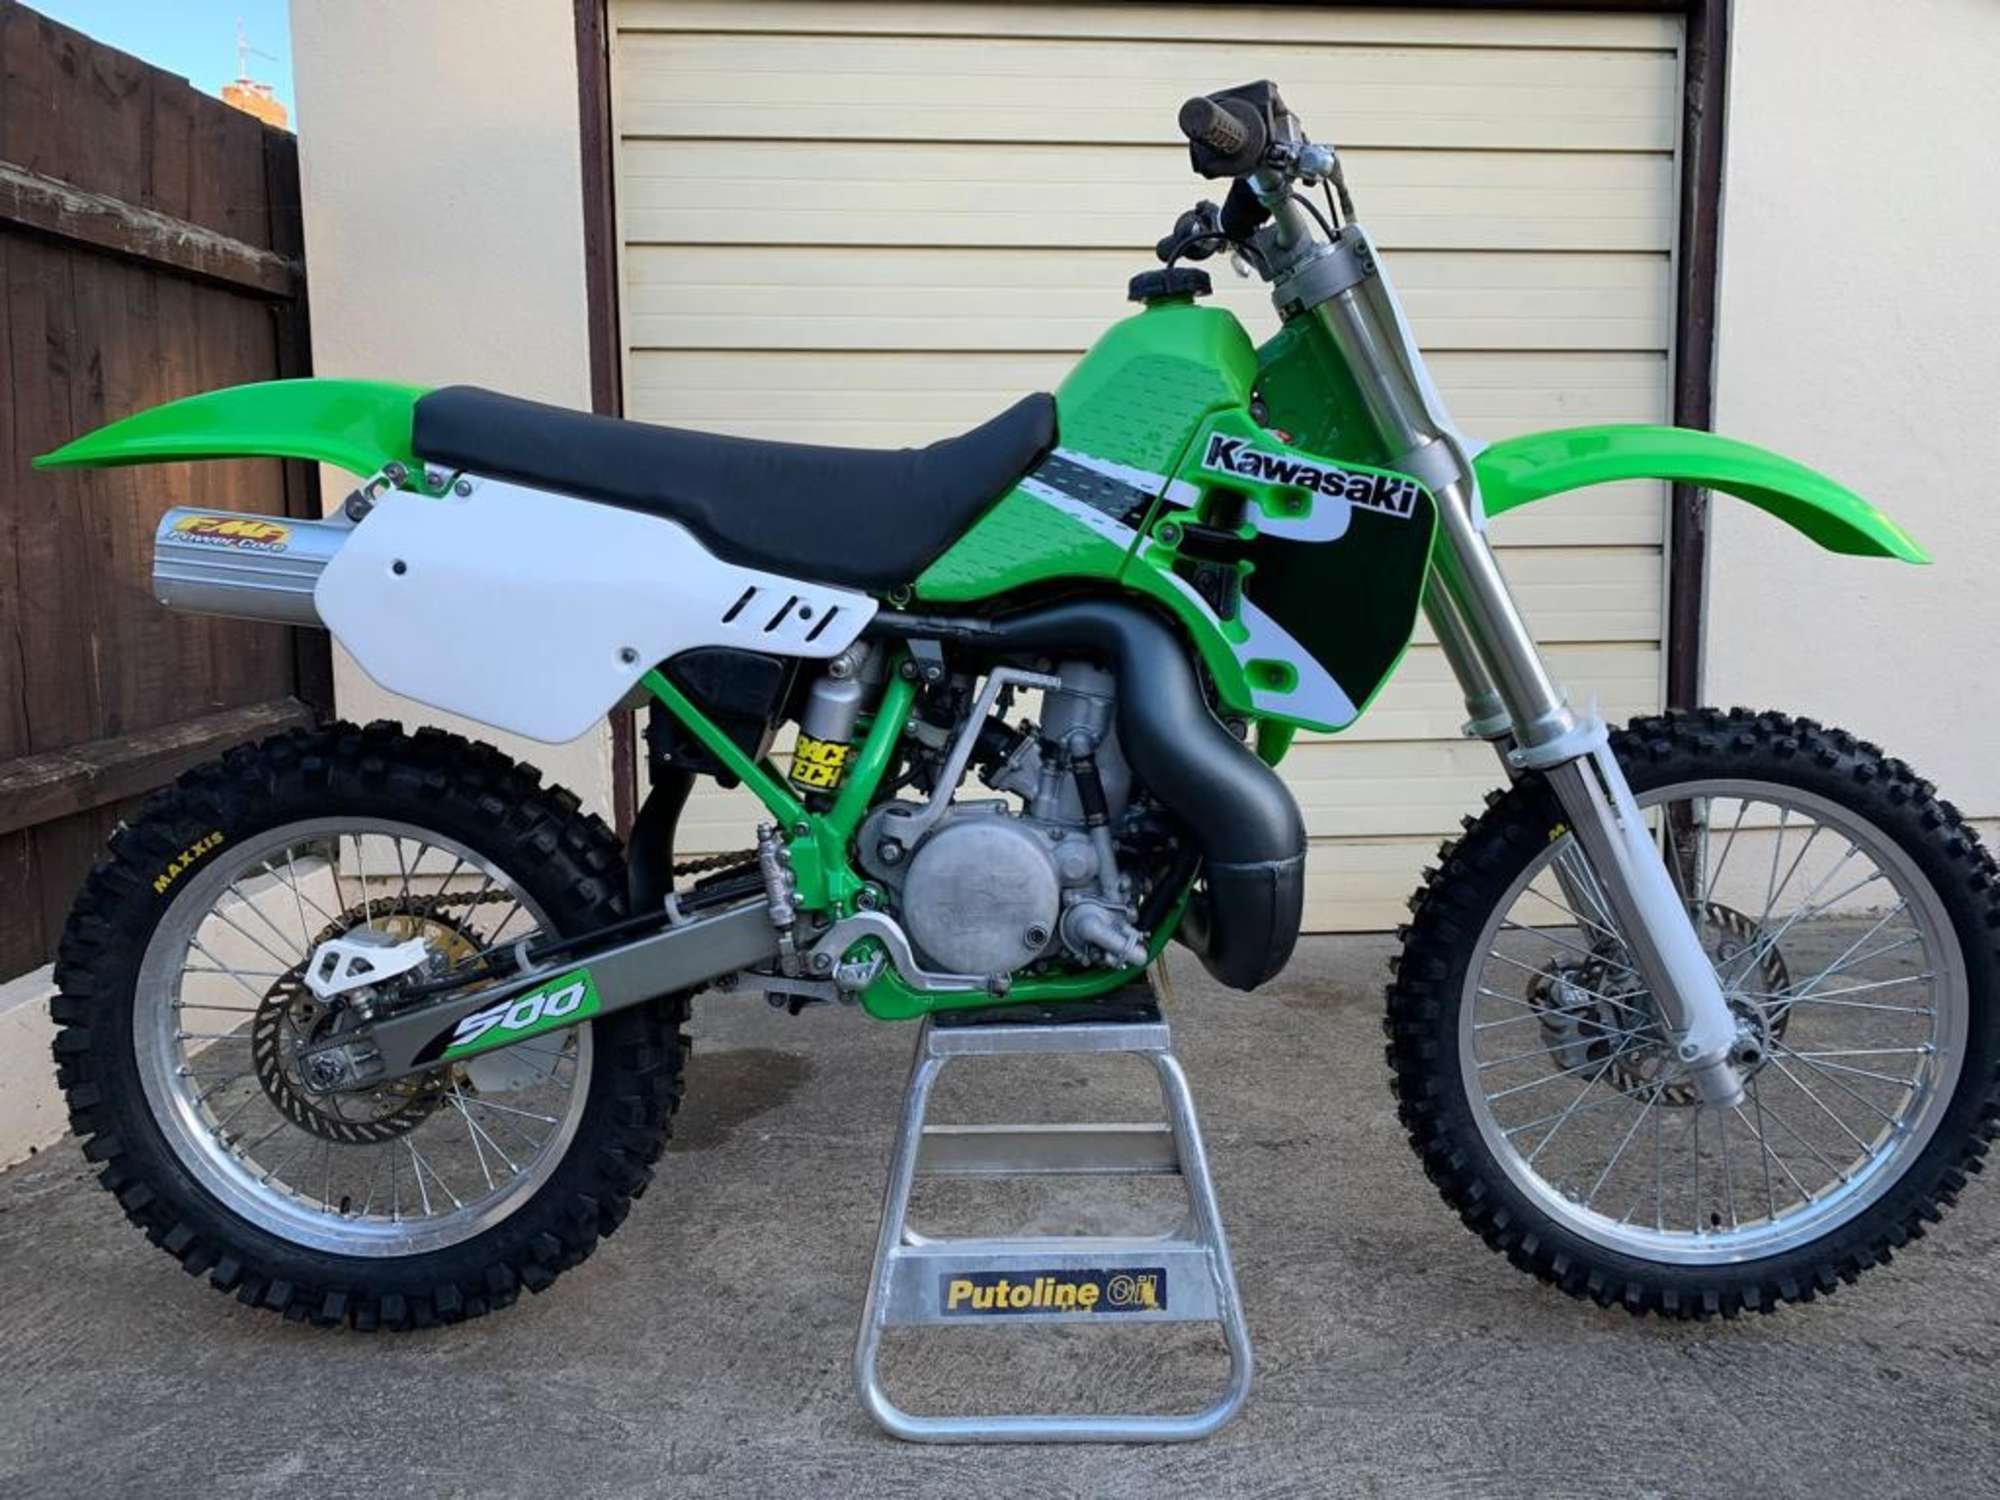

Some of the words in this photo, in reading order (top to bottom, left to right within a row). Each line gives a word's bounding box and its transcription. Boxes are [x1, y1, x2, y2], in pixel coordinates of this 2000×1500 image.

[1203, 434, 1417, 516] Kawasaki
[153, 831, 224, 894] MAXXIS
[447, 981, 586, 1047] 500
[947, 1277, 1100, 1310] Putoline
[1106, 1274, 1158, 1307] Oil
